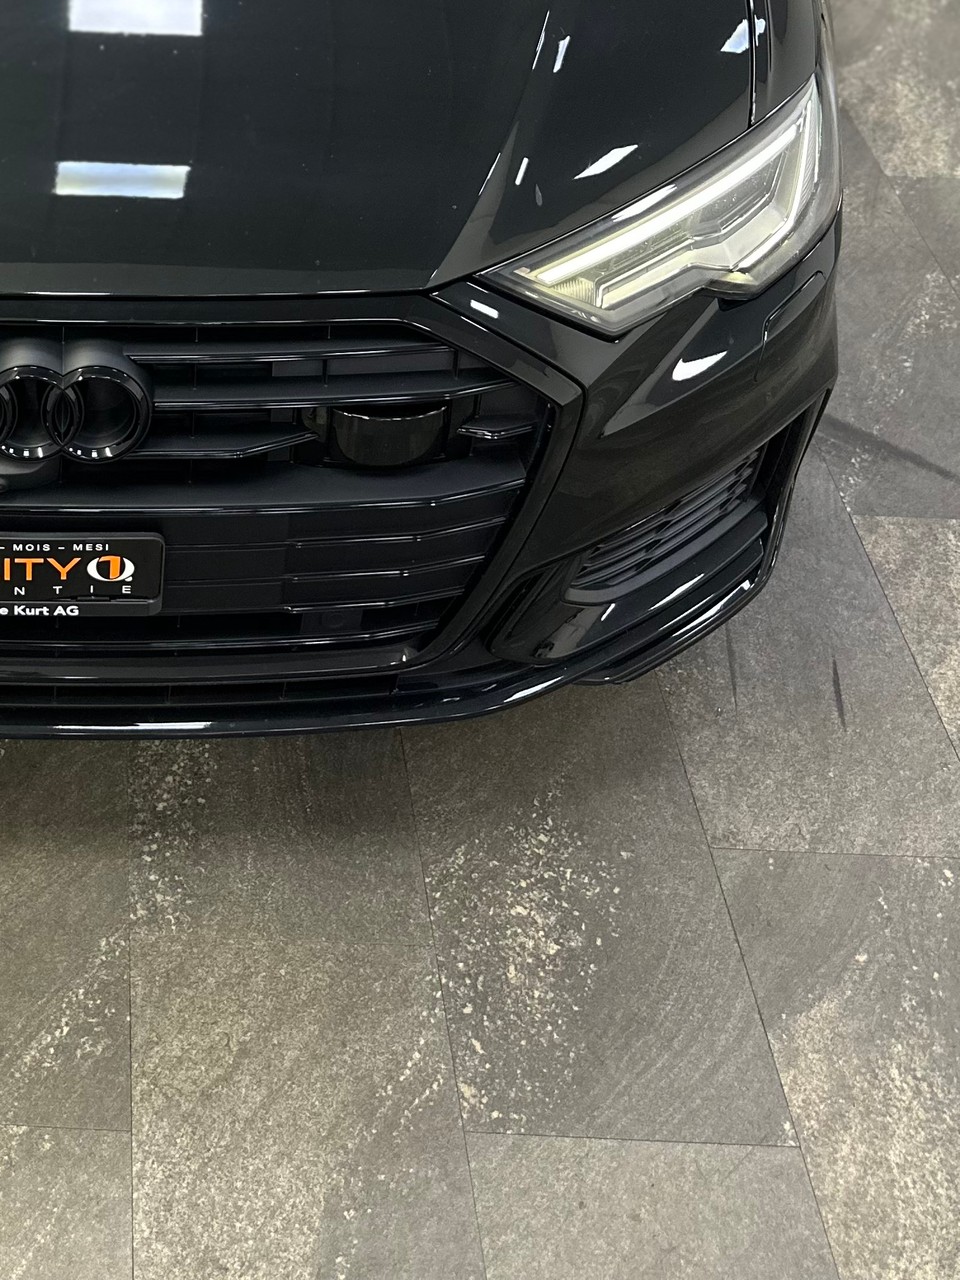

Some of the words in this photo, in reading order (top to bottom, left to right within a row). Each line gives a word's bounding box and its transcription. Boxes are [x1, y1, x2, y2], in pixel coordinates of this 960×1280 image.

[12, 543, 51, 552] MOIS
[72, 543, 110, 552] MESI
[13, 604, 52, 617] Kurt
[53, 605, 80, 617] AG
